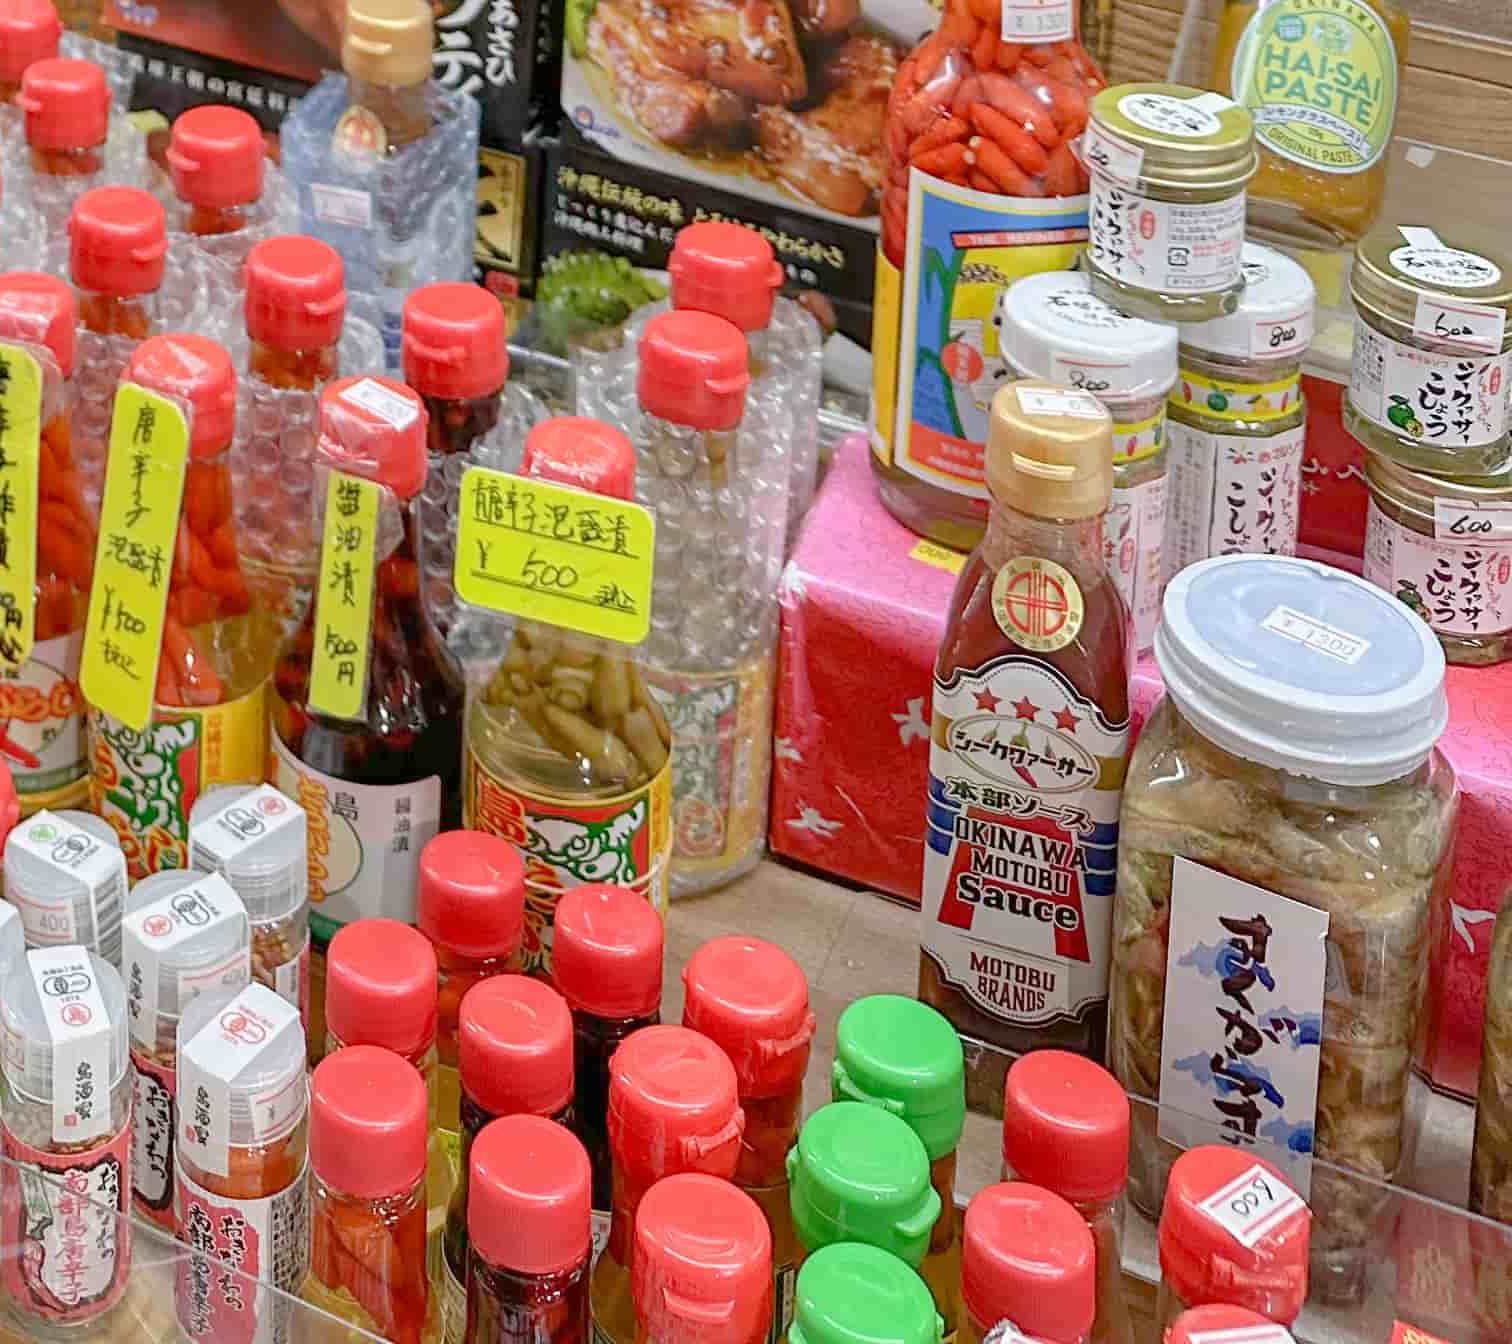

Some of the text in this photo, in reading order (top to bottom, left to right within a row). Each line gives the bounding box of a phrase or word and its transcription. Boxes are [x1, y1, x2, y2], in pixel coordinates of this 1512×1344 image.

[1265, 43, 1382, 102] HAI-SAI
[1265, 68, 1373, 127] PASTE
[1267, 126, 1354, 164] ORIGINAL PASTE
[1433, 312, 1474, 338] 600
[1417, 371, 1449, 439] こしょう
[1449, 515, 1494, 535] 600
[477, 538, 490, 572] ¥
[522, 550, 579, 590] 500
[1424, 558, 1458, 625] こしょう
[944, 774, 1096, 836] 本部ソース
[955, 814, 1088, 875] OKINAWA
[972, 847, 1071, 897] MOTOBU
[957, 872, 1080, 930] Sauce
[969, 949, 1057, 995] MOTOBU
[976, 975, 1047, 1014] BRANDS
